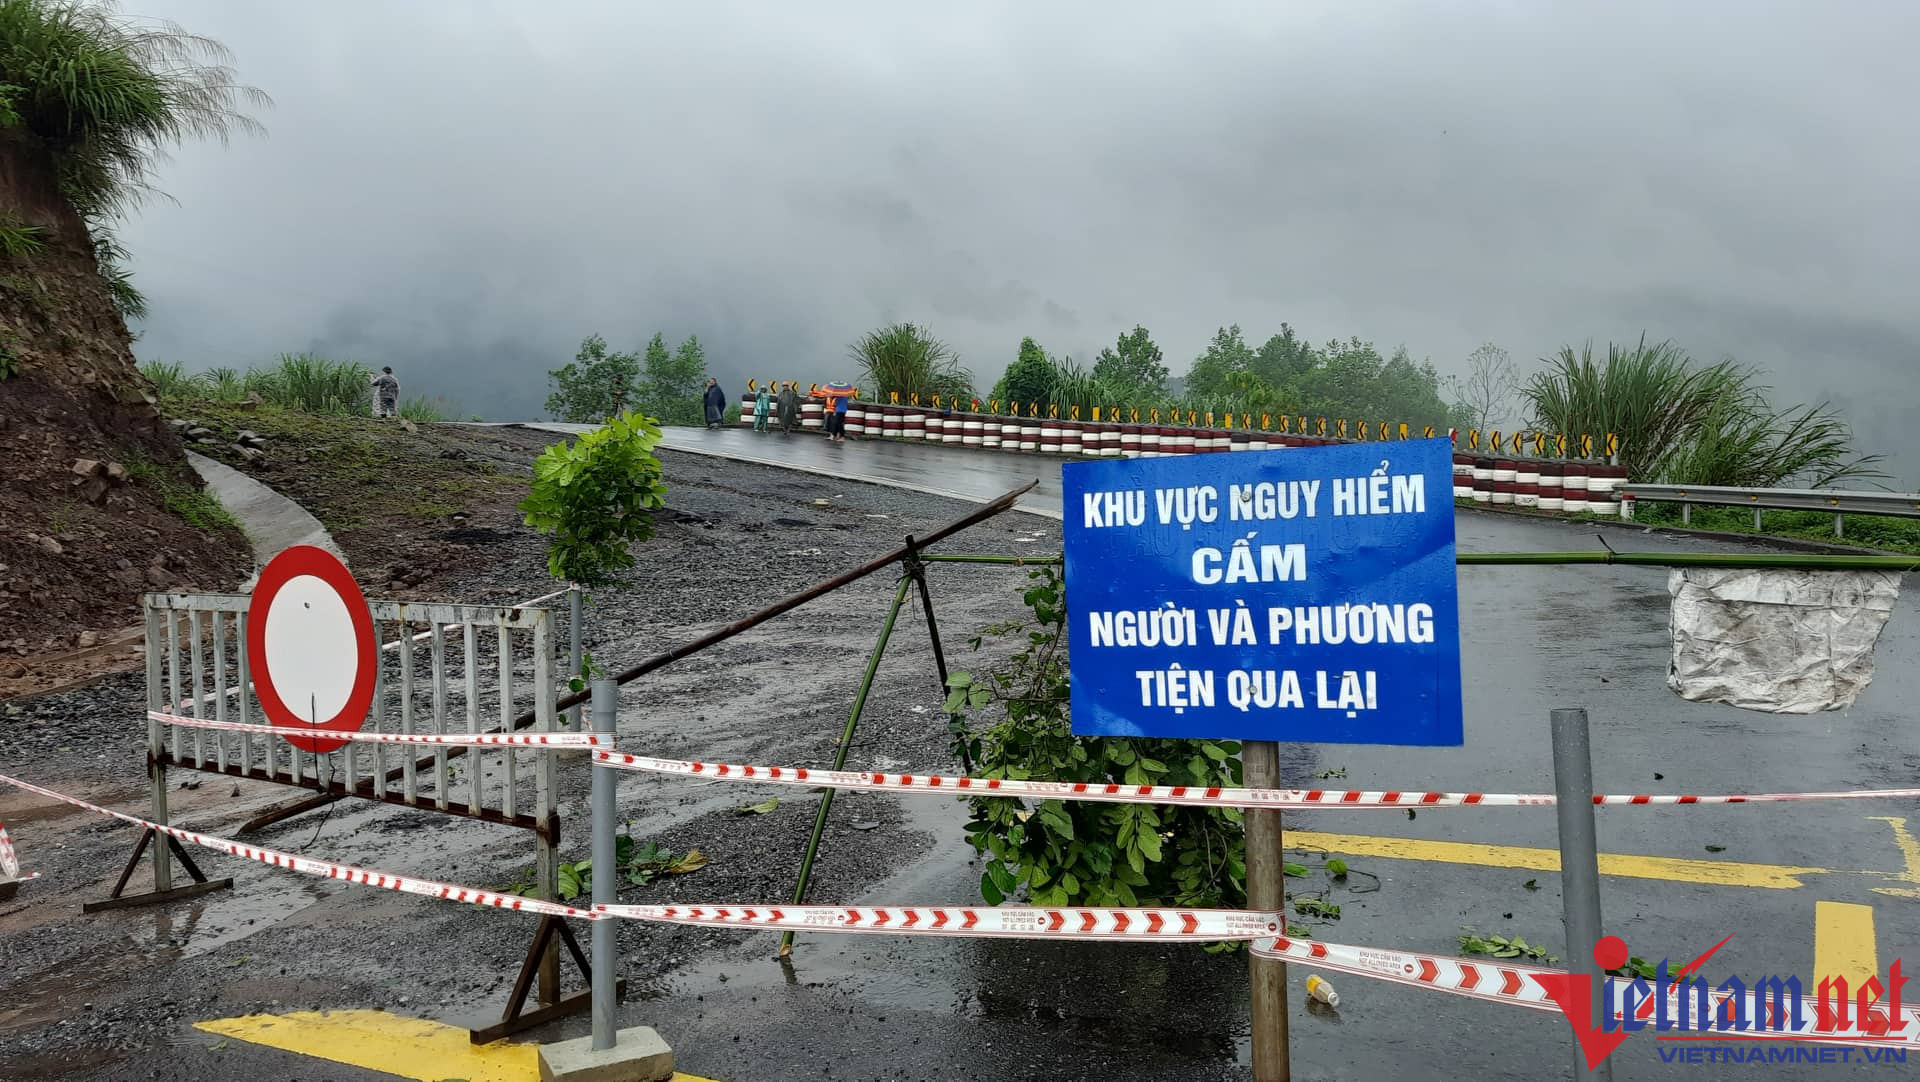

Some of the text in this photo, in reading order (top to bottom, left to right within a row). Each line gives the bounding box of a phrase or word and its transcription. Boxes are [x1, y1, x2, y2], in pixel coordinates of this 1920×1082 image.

[1084, 460, 1425, 531] KHU VỰC NGUY HIỂM
[1191, 532, 1307, 585] CẤM
[1089, 599, 1434, 647] NGƯỜI VÀ PHƯƠNG
[1136, 662, 1377, 718] TIỆN QUA LẠI
